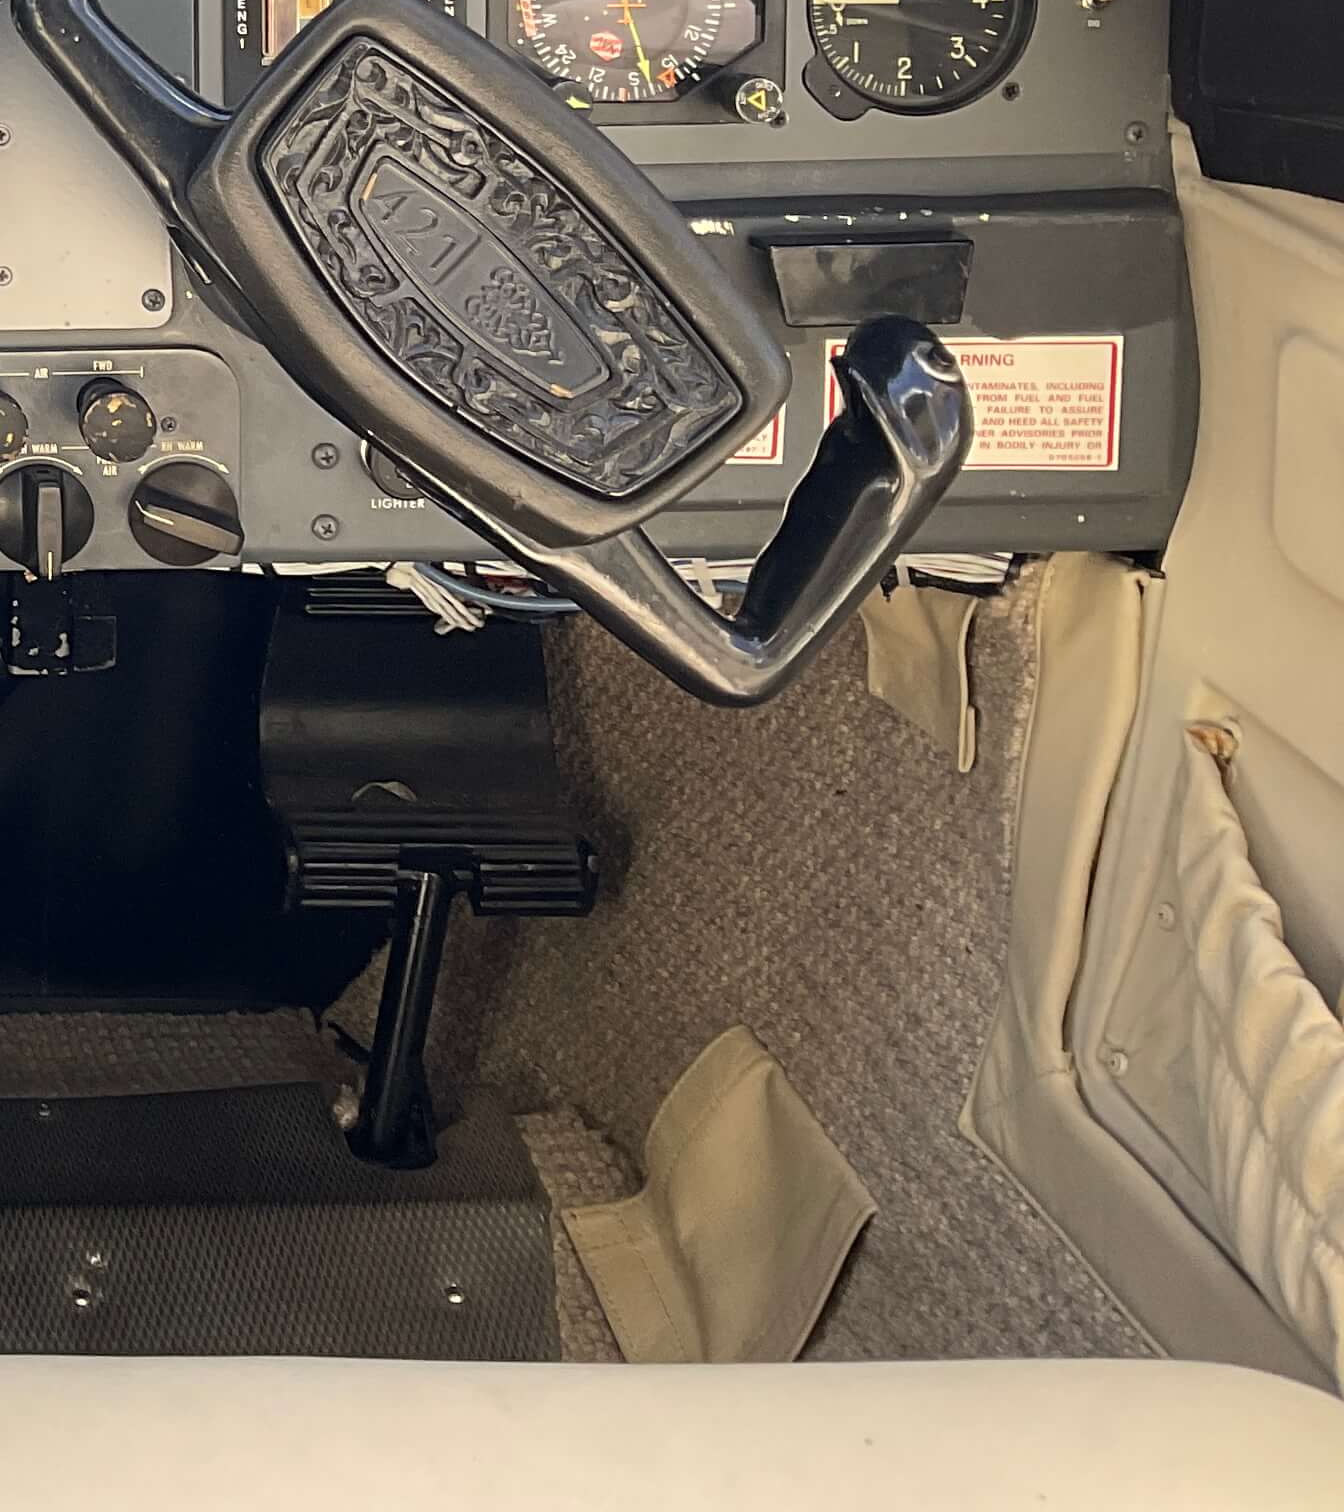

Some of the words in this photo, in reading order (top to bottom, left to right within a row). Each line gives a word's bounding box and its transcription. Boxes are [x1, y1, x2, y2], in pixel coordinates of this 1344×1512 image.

[960, 354, 1014, 366] RNING
[1046, 382, 1105, 391] INCLUDING
[977, 394, 1007, 402] FROM
[1015, 394, 1040, 402] FUEL
[1048, 394, 1071, 402] AND
[1079, 394, 1104, 402] FUEL
[987, 406, 1031, 414] FAILURE
[1040, 406, 1053, 414] TO
[1062, 406, 1104, 414] ASSURE
[982, 418, 1004, 426] AND
[1009, 418, 1037, 426] HEED
[1063, 418, 1104, 426] SAFETY
[1001, 430, 1063, 438] ADVISORIES
[980, 441, 990, 449] IN
[997, 441, 1035, 449] BODILY
[1042, 441, 1080, 449] INJURY
[1087, 441, 1102, 449] OR
[369, 497, 426, 510] LIGHTER
